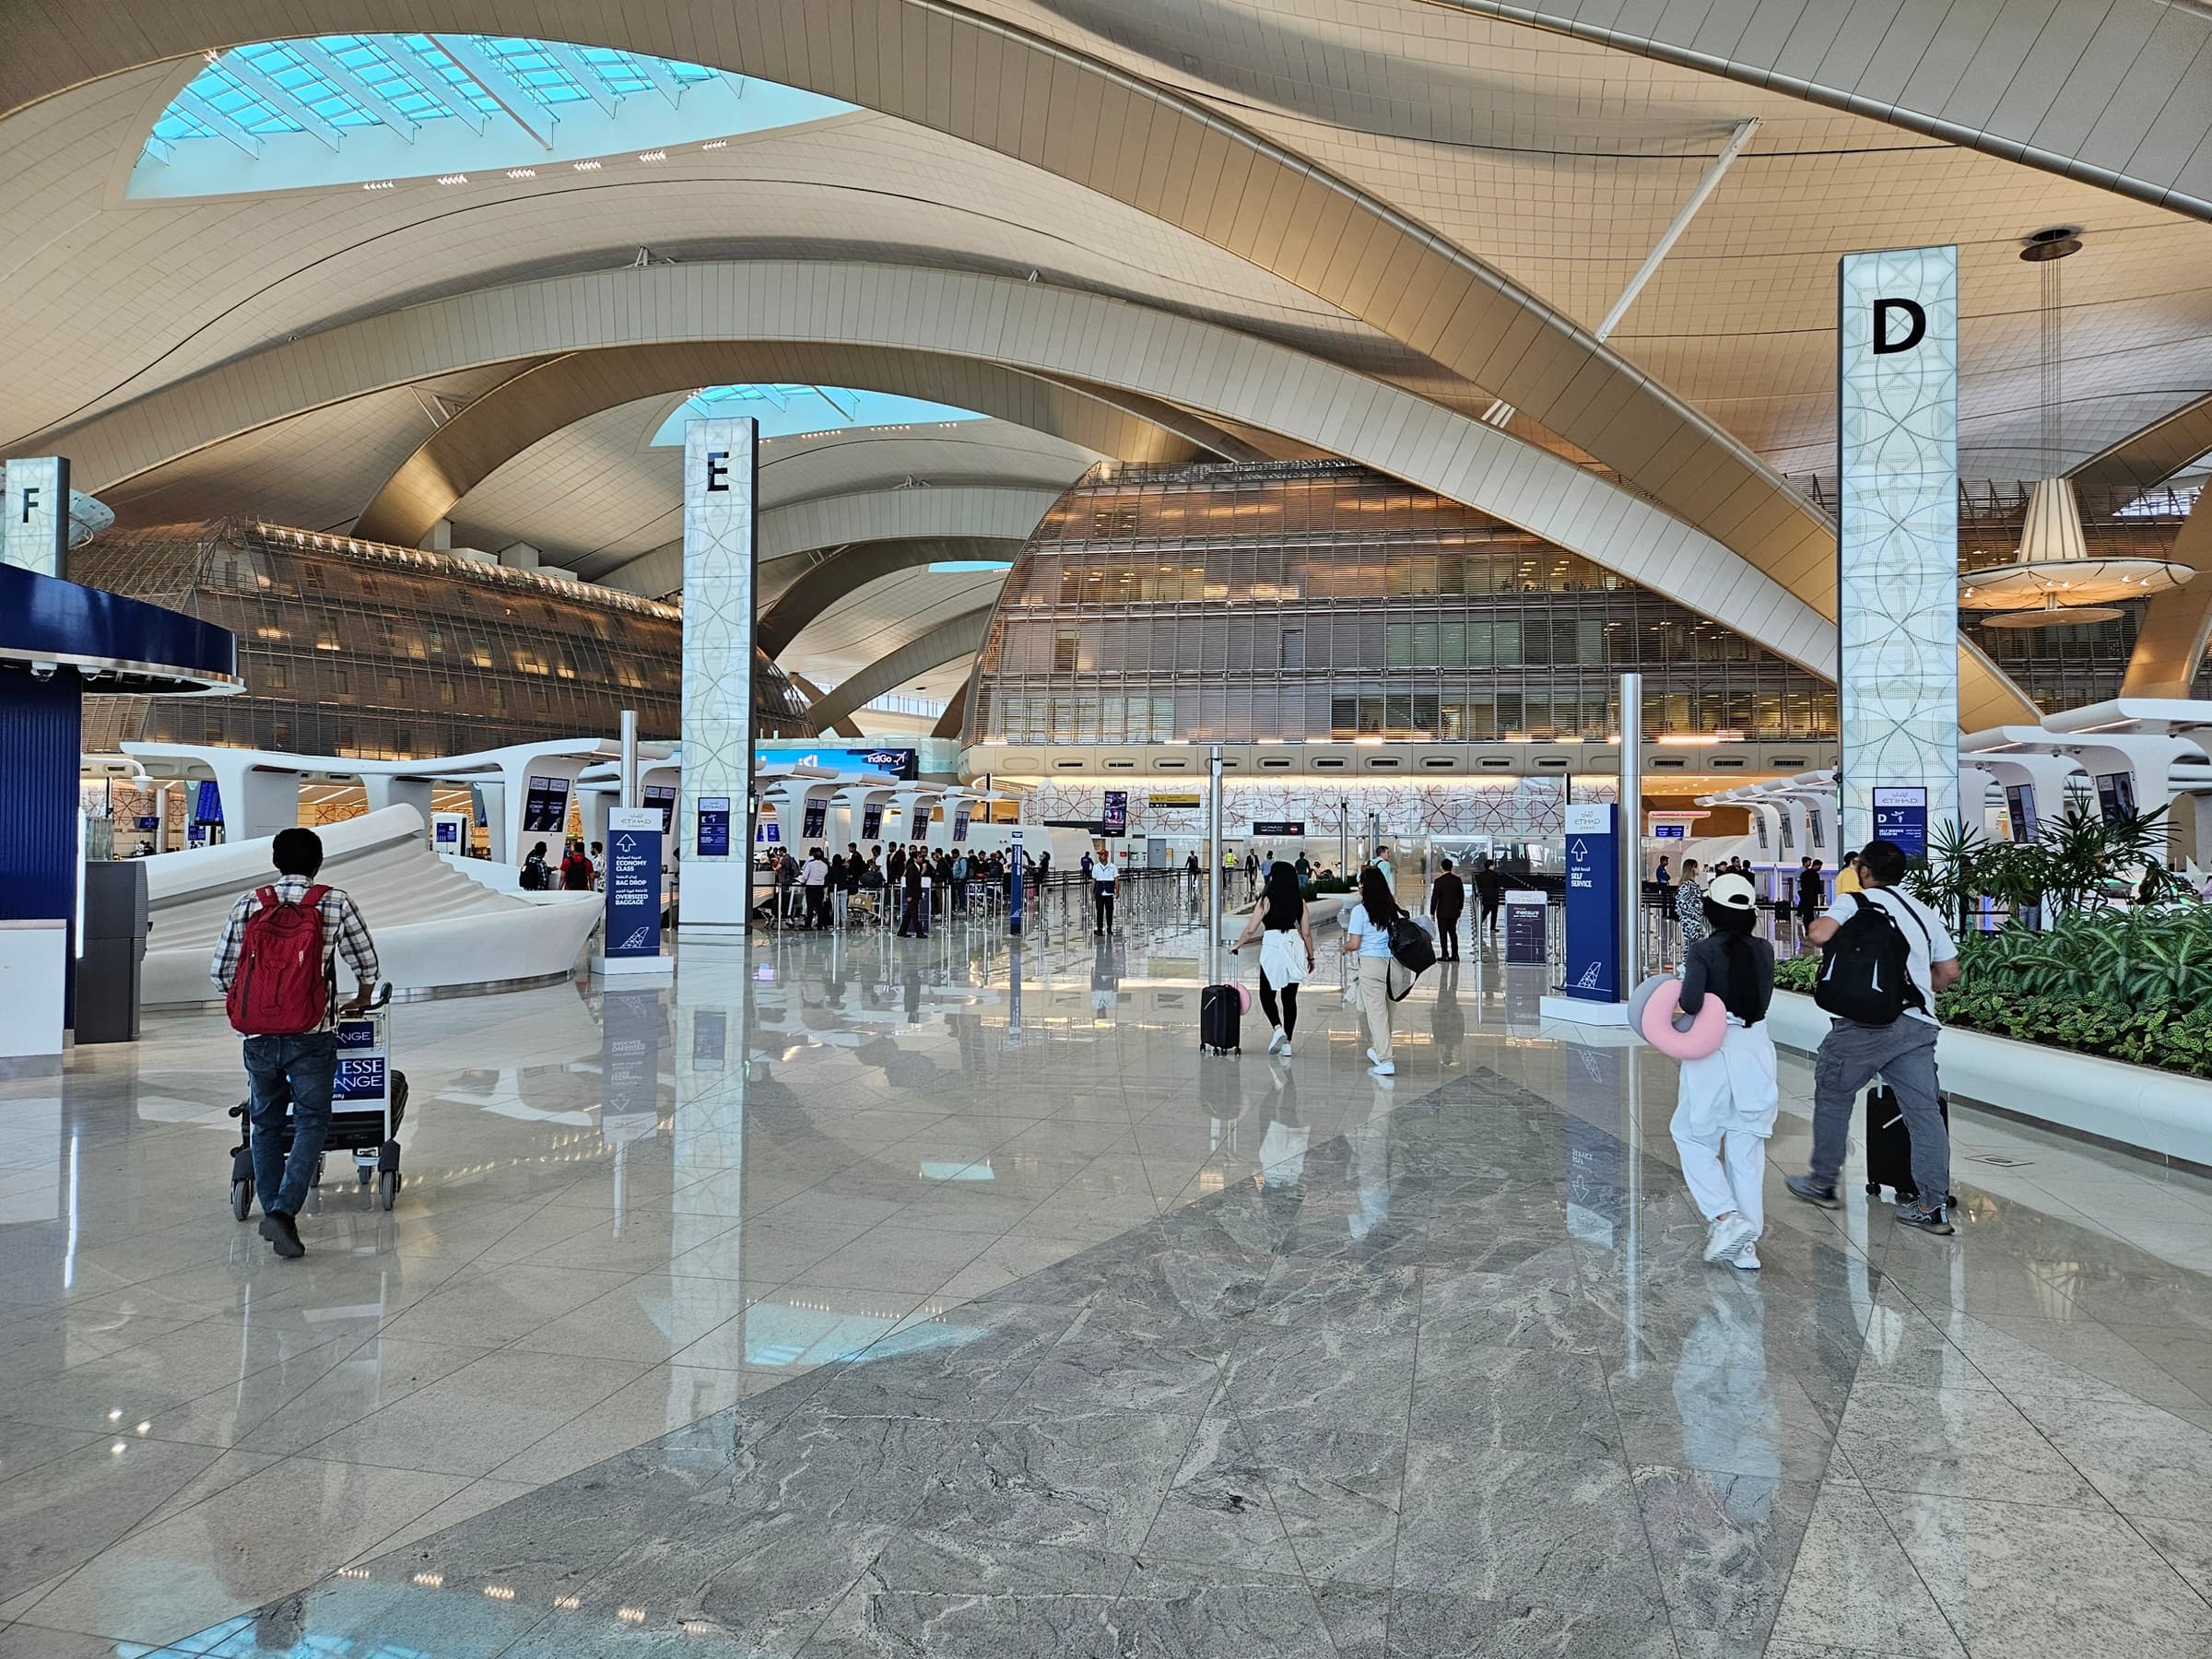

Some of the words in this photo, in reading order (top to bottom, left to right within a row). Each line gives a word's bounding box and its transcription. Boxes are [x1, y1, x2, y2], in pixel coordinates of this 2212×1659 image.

[1873, 298, 1926, 355] D
[707, 452, 729, 491] E
[23, 488, 39, 523] F
[868, 755, 892, 763] IndiGo
[1877, 814, 1887, 823] D
